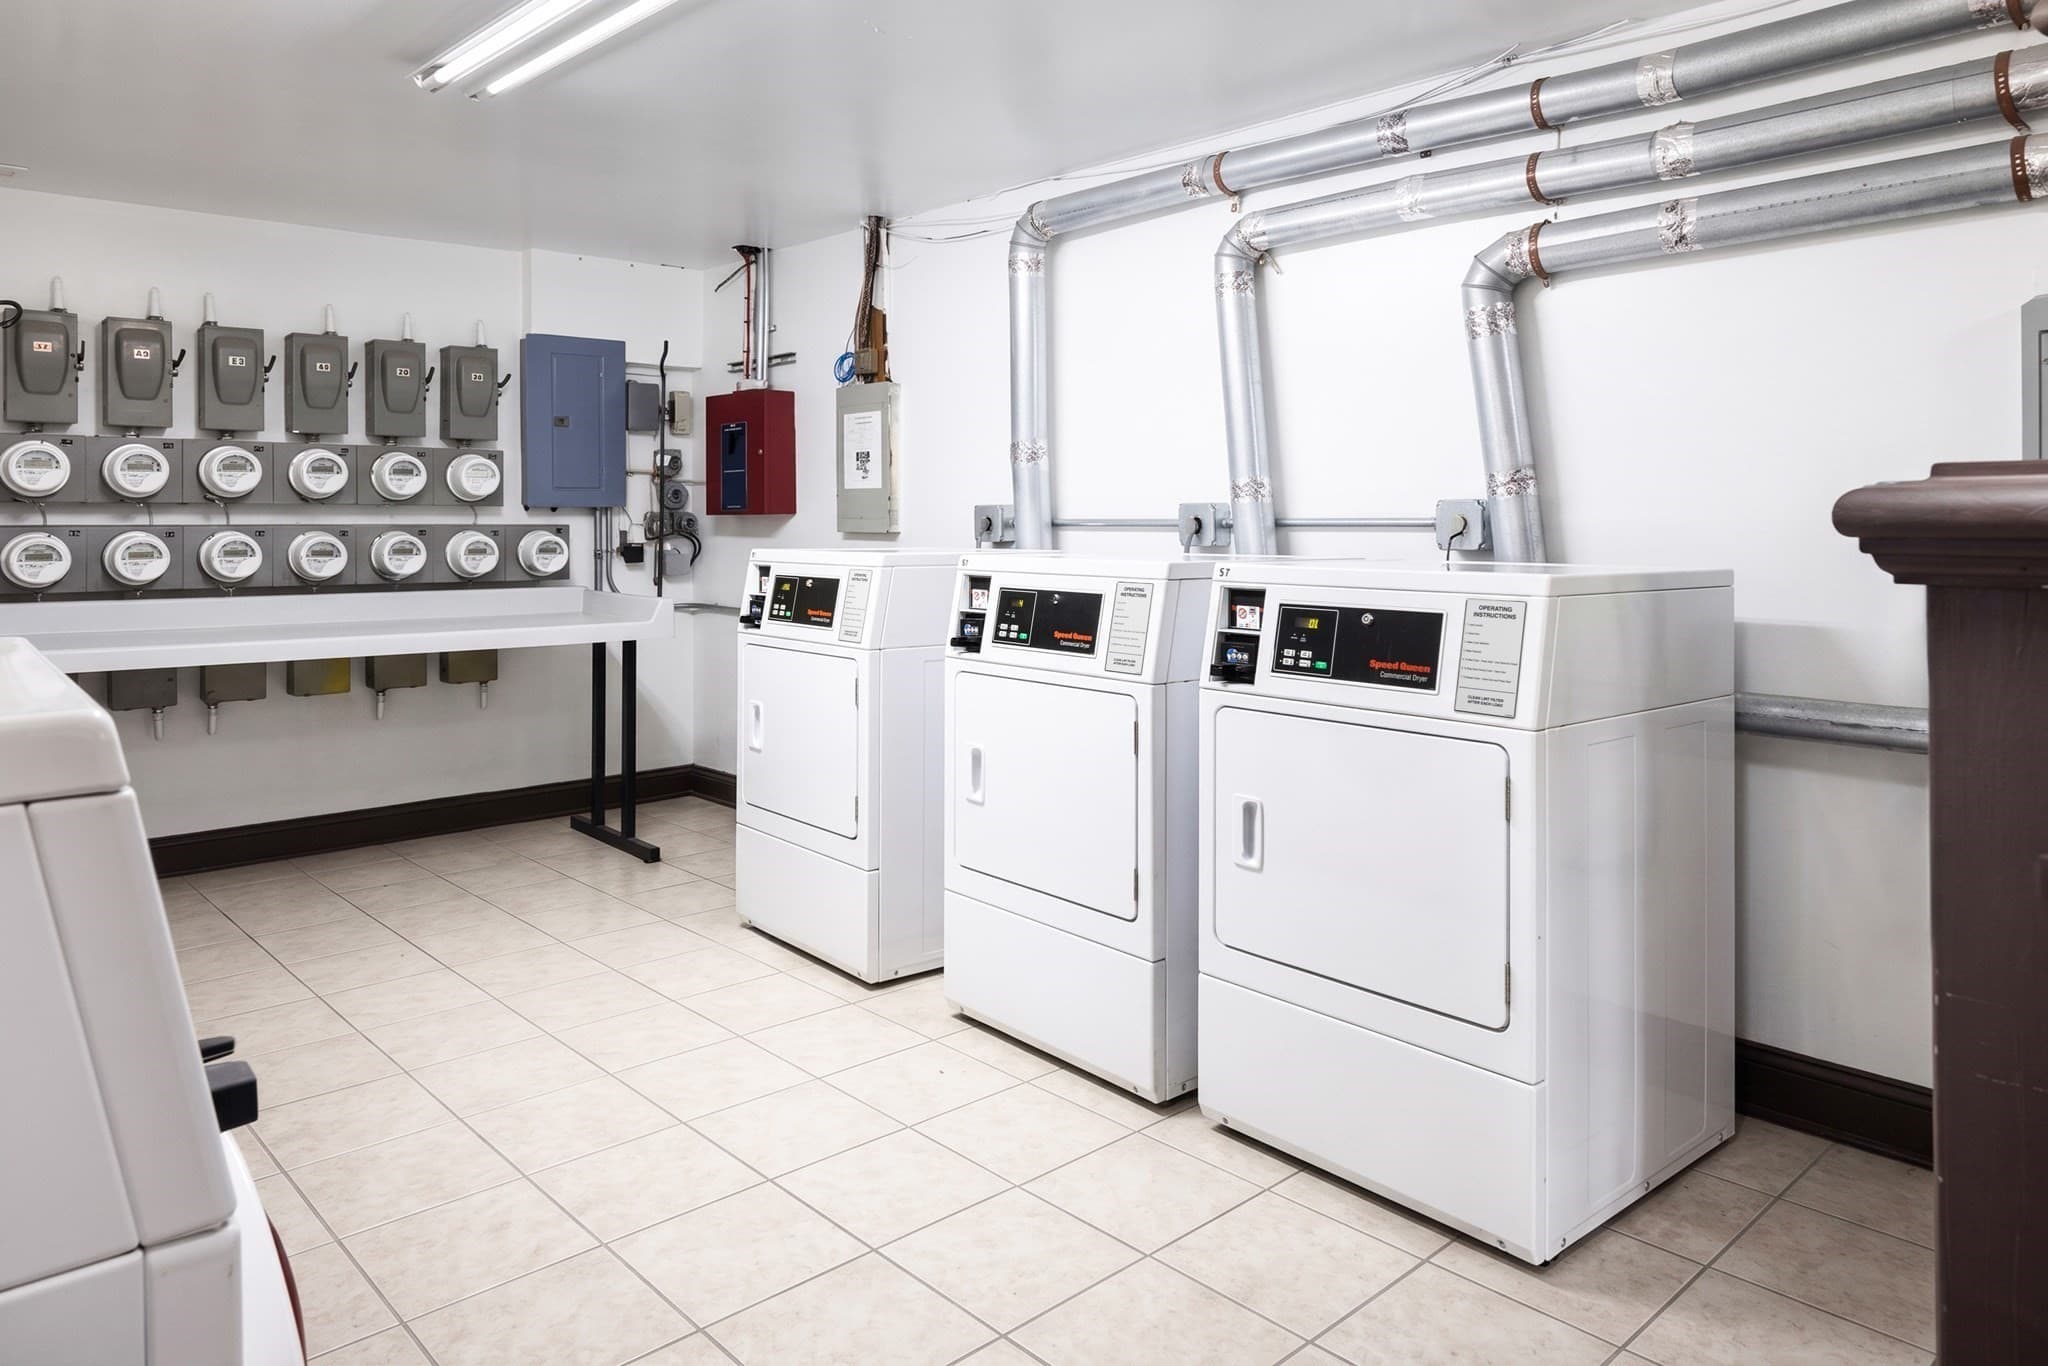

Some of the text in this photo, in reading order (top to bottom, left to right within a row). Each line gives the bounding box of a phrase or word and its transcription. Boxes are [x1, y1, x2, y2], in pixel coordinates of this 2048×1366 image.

[1478, 604, 1512, 612] OPERATING
[1473, 612, 1517, 620] INSTRUCTIONS
[1369, 659, 1431, 672] Speed Queen
[1380, 671, 1428, 682] Commercial Dryer
